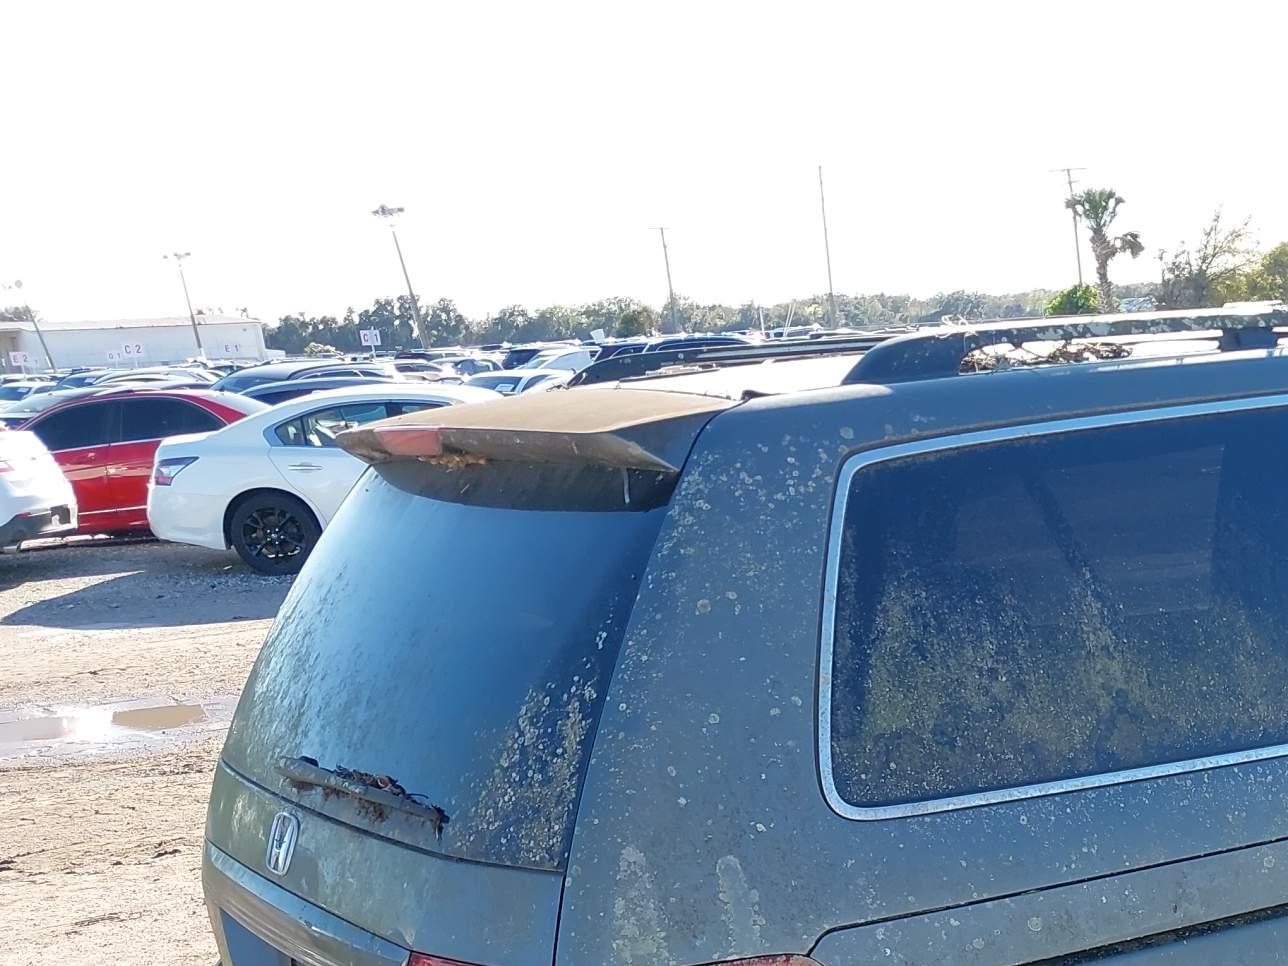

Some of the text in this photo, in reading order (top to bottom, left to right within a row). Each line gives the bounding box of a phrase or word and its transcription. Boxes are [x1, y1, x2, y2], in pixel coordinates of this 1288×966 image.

[363, 333, 370, 343] C
[124, 344, 142, 354] C 2
[224, 344, 231, 353] E
